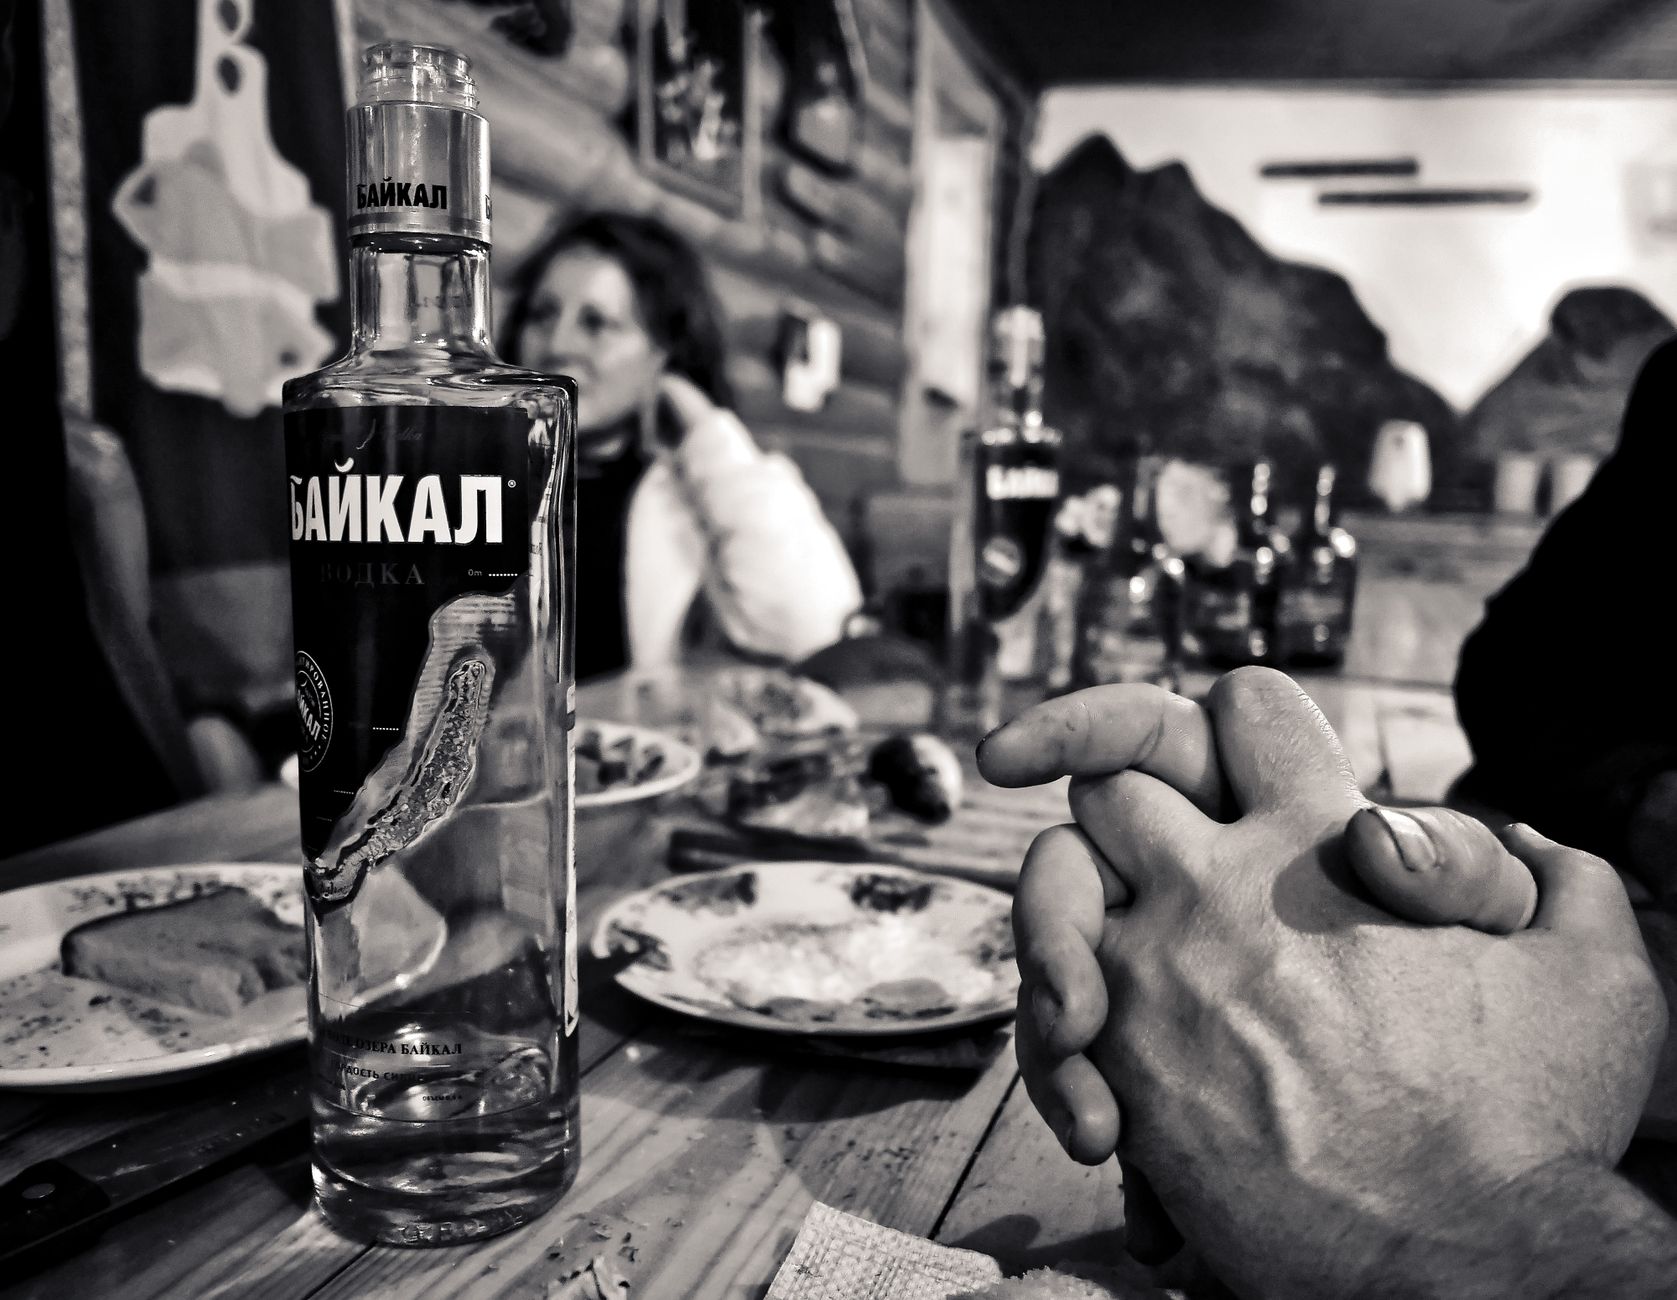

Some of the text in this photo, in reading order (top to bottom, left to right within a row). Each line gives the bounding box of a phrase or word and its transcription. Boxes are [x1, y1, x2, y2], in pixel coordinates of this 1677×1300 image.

[357, 177, 448, 210] БАЙКАЛ
[290, 457, 503, 544] БАЙКАЛ
[320, 562, 426, 589] ВОДКА
[356, 1038, 463, 1056] ОЗЕРА БАЙКАЛ
